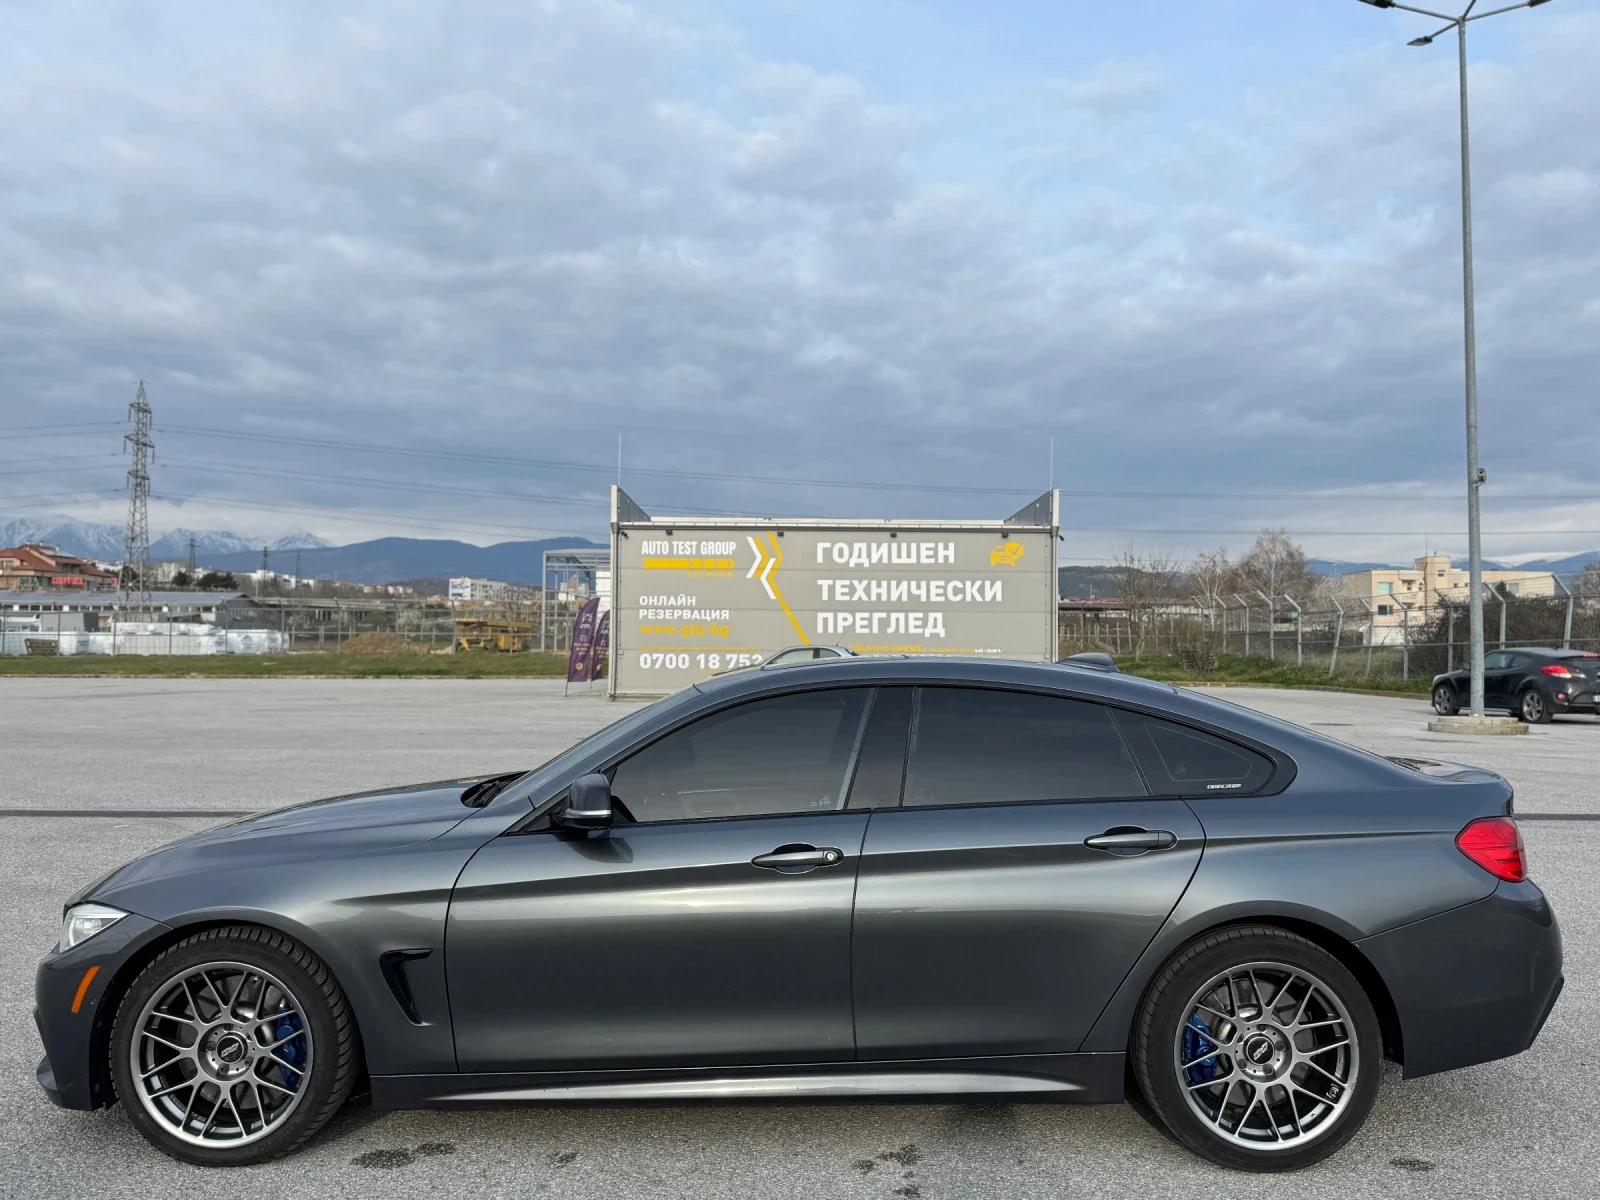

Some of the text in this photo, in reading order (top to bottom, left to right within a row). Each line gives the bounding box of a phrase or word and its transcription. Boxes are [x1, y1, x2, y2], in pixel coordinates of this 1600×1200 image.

[641, 541, 737, 555] AUTO TEST GROUP
[816, 542, 955, 567] ГОДИШЕН
[817, 579, 1003, 602] ТЕХНИЧЕСКИ
[639, 594, 696, 606] ОНЛАЙН
[639, 609, 729, 621] РЕЗЕРВАЦИЯ
[640, 623, 730, 638] www.gtp.bg
[817, 612, 946, 638] ПРЕГЛЕД
[639, 653, 689, 669] 0700
[696, 653, 720, 669] 18
